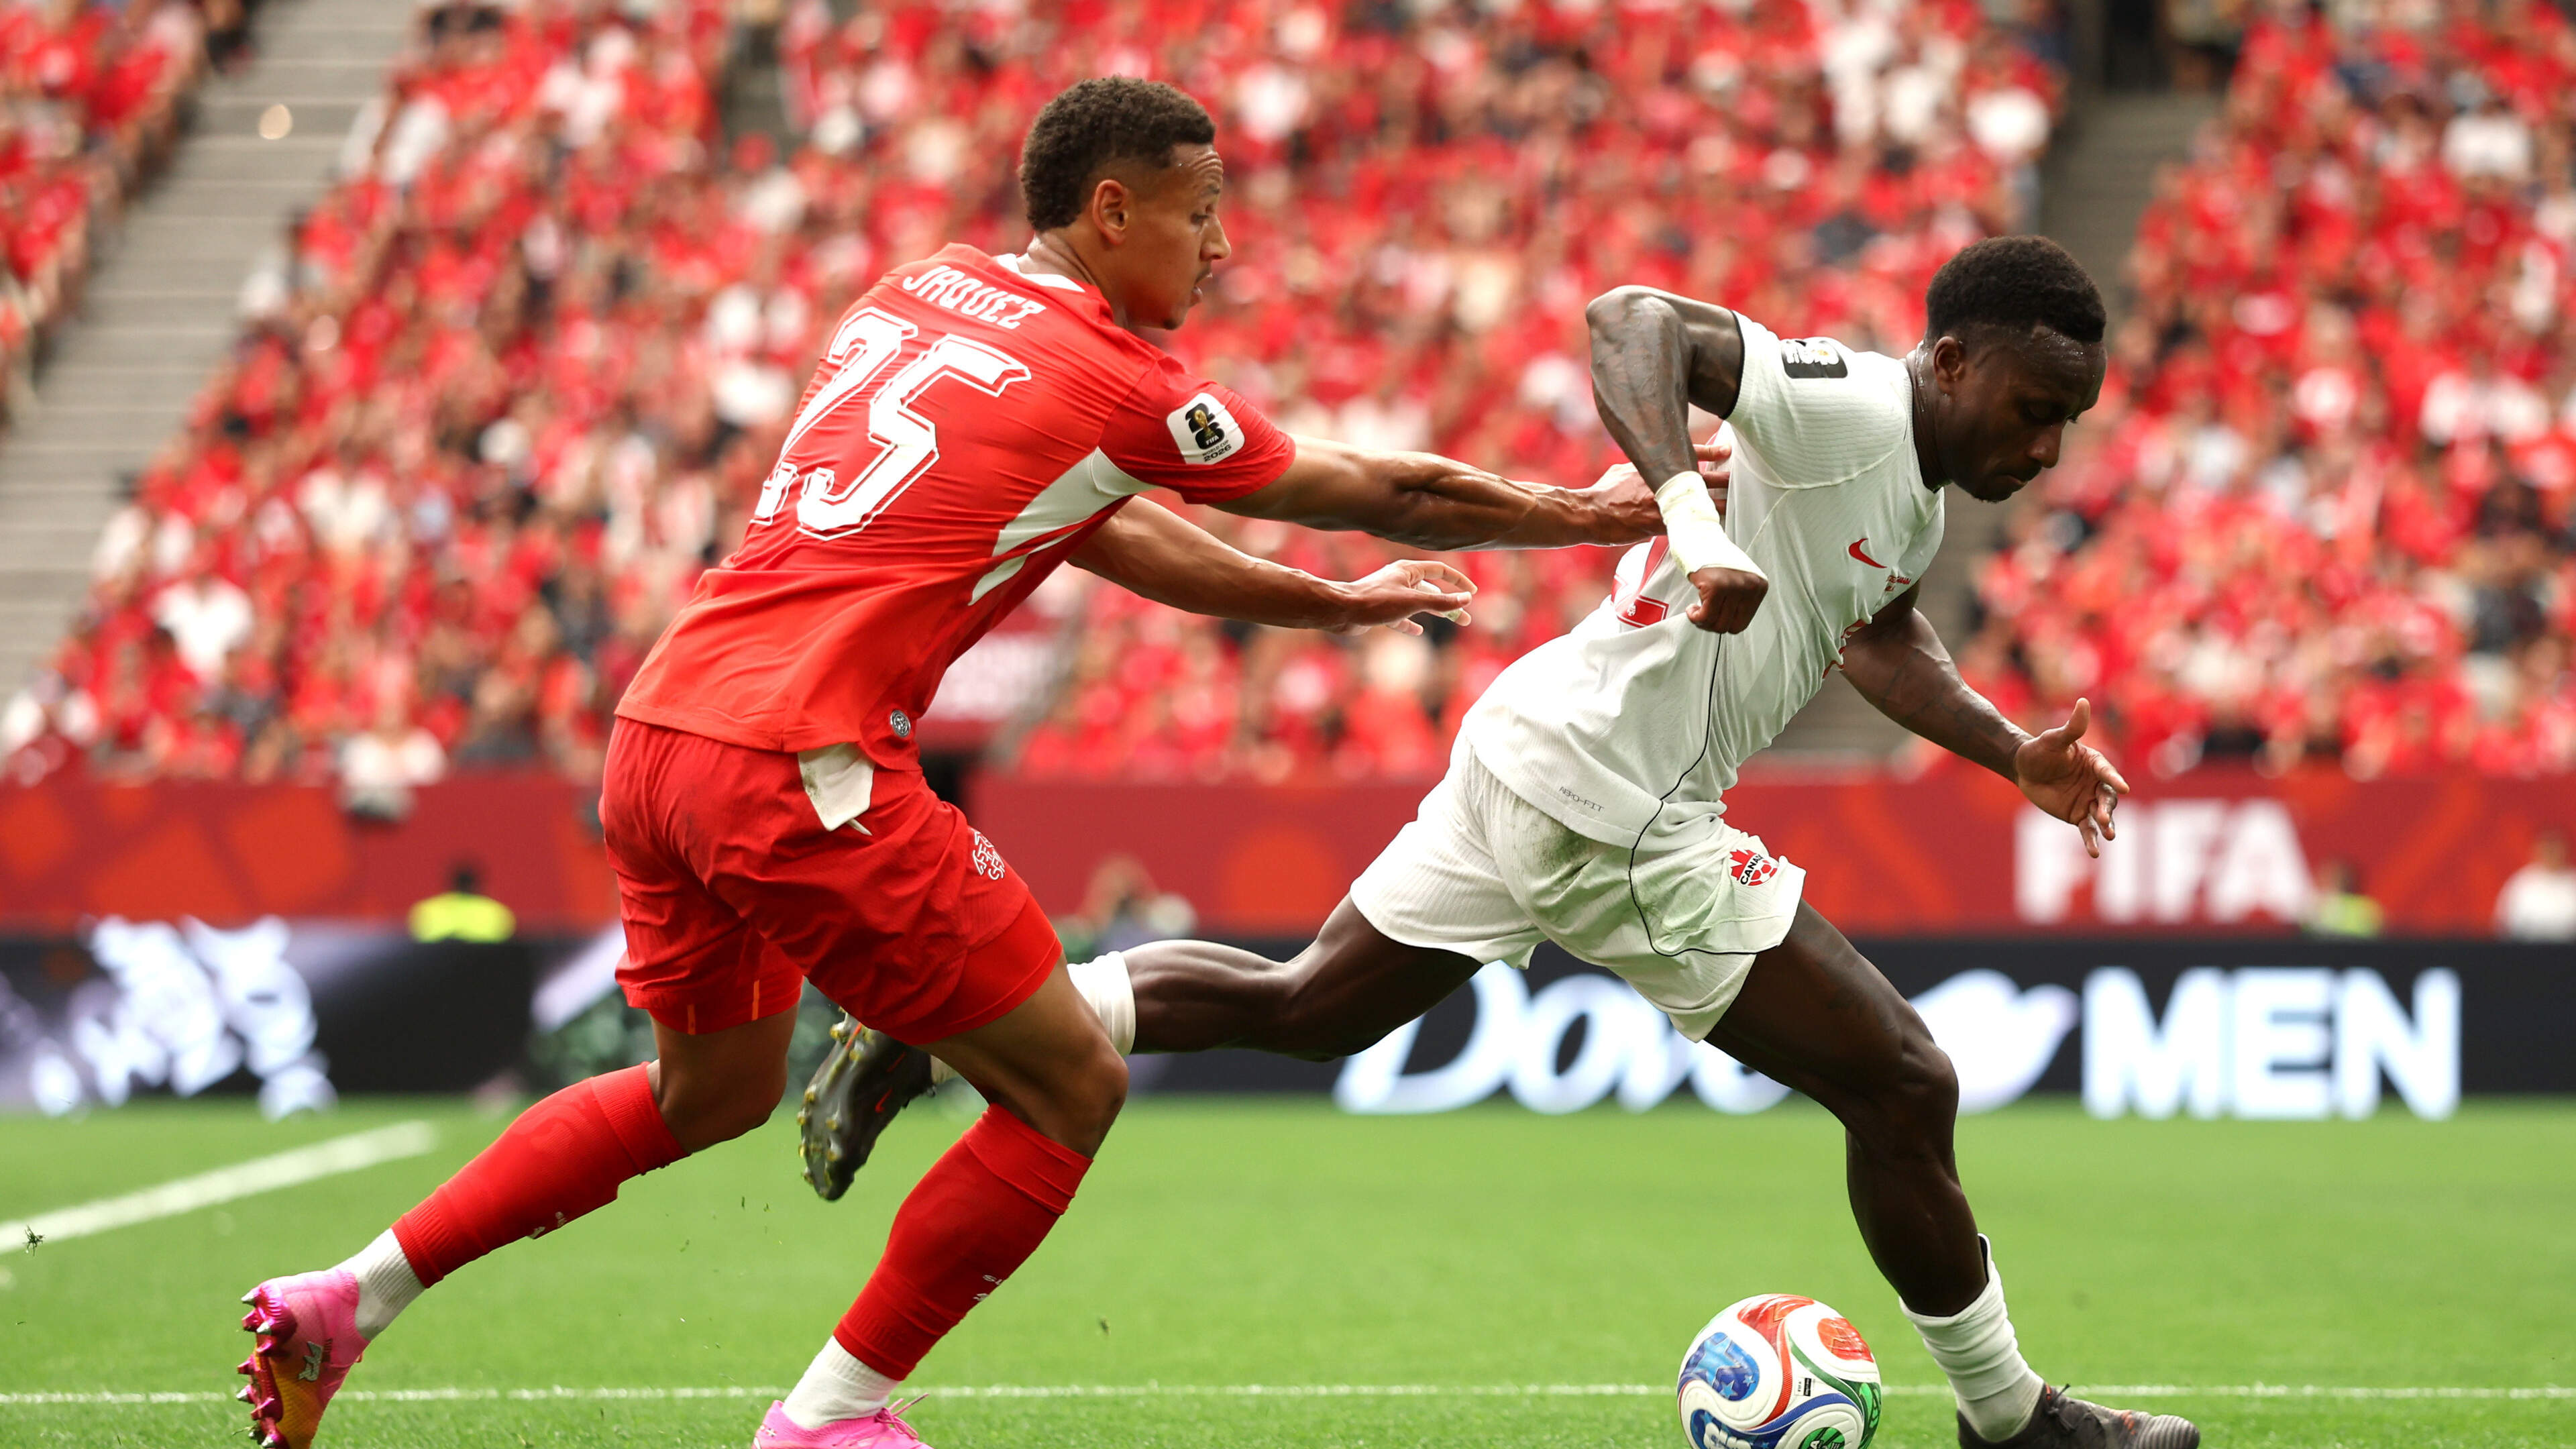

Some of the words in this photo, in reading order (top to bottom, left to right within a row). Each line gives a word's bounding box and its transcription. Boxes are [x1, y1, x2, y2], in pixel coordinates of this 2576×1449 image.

[902, 265, 1047, 329] JAQUEZ
[749, 306, 1032, 541] 25
[1202, 445, 1220, 457] WORLD
[1203, 444, 1232, 462] 2026
[1205, 435, 1220, 445] FIFA
[2015, 798, 2312, 922] FIFA
[2082, 967, 2461, 1120] MEN
